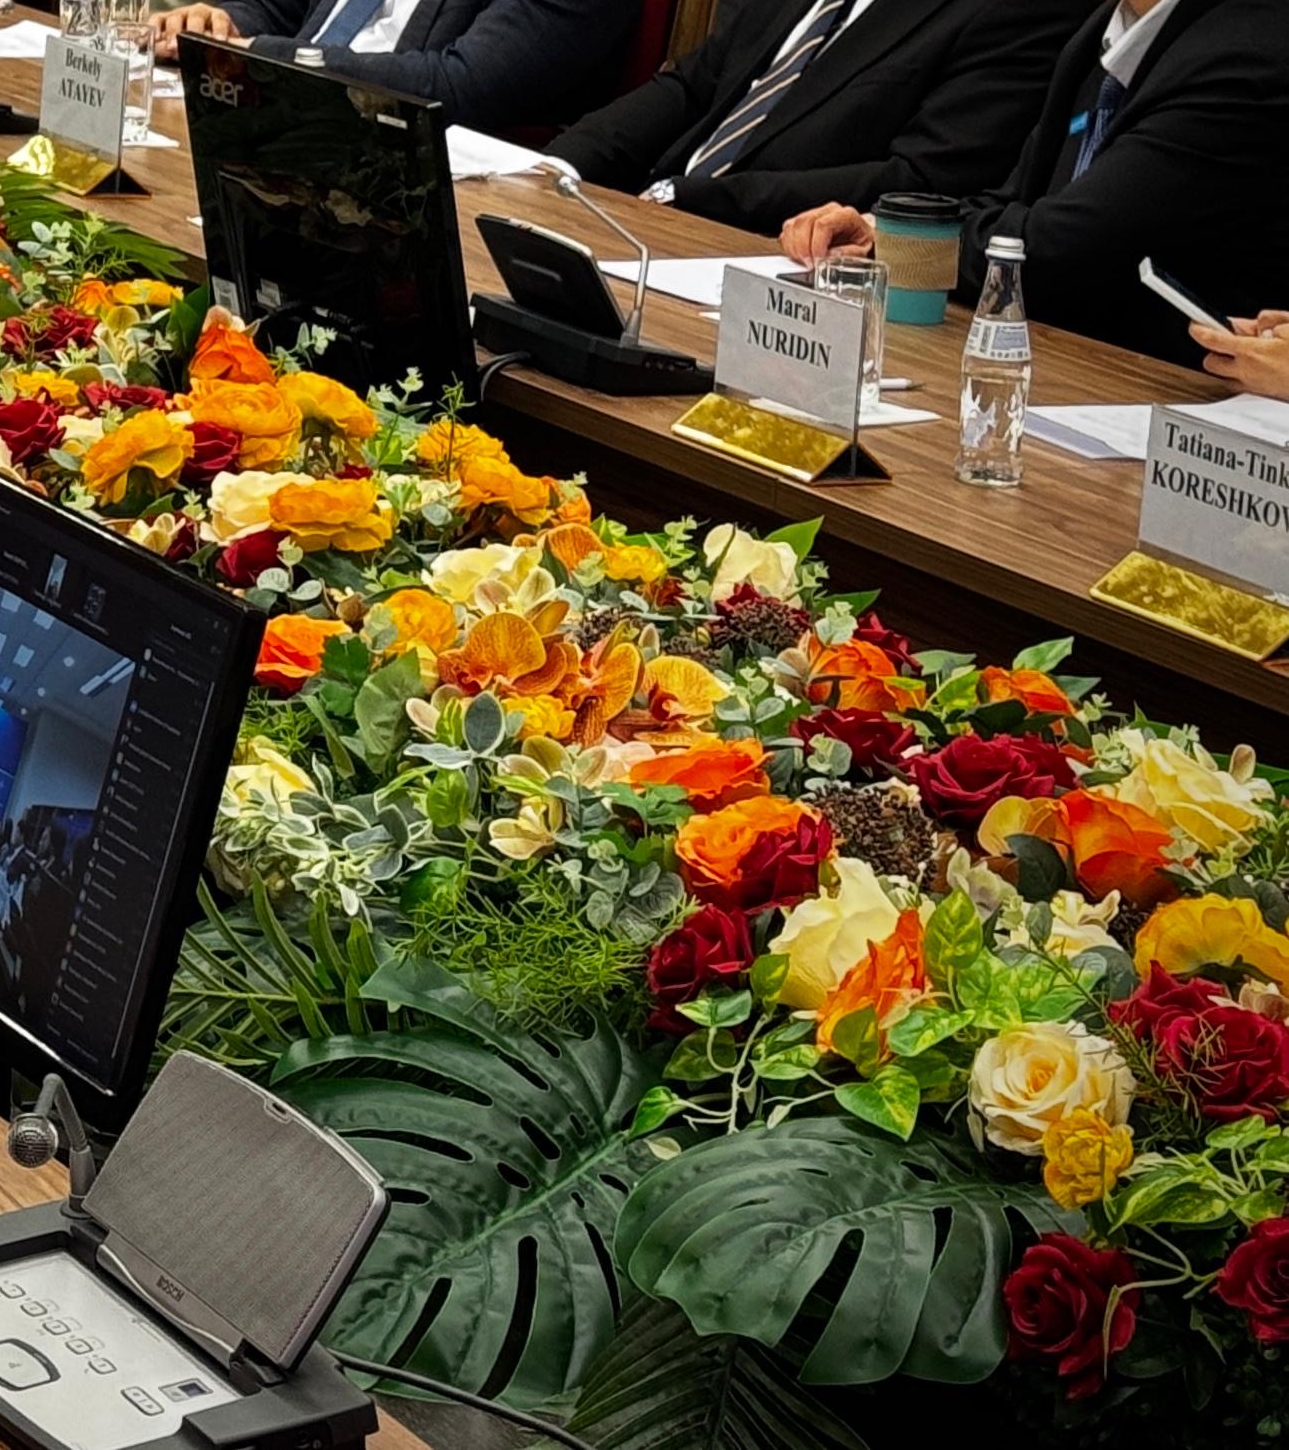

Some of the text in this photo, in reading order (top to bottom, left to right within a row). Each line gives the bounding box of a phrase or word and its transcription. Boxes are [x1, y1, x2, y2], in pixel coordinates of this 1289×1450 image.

[66, 48, 103, 83] Berkely
[58, 78, 105, 108] ATAYEV
[199, 73, 245, 108] acer
[766, 287, 816, 325] Maral
[747, 319, 832, 370] NURIDIN
[156, 1275, 185, 1302] BOSCH
